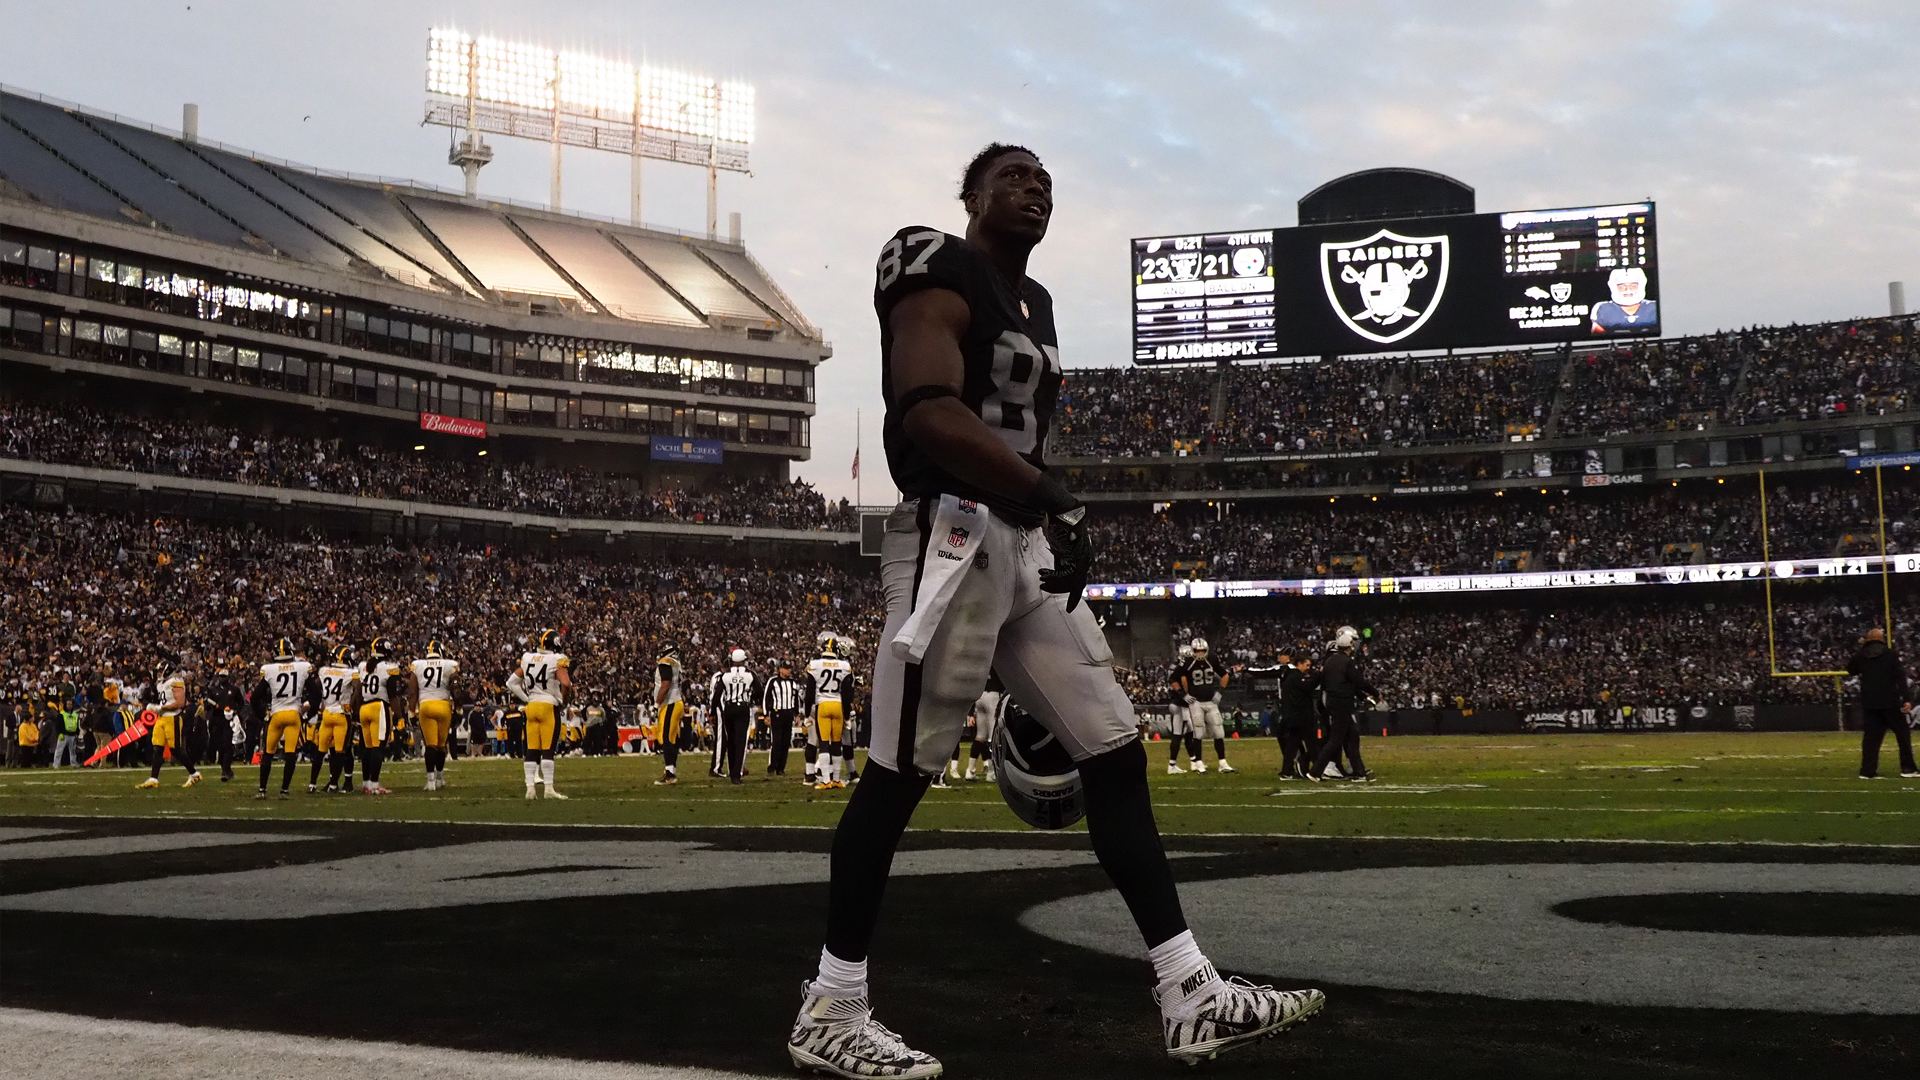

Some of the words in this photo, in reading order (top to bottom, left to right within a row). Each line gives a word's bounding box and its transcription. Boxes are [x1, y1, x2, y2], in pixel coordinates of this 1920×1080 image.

[877, 231, 945, 291] 87
[1337, 243, 1433, 262] RAIDERS
[1142, 258, 1169, 280] 23
[1203, 254, 1228, 276] 21
[1209, 283, 1237, 293] BALL
[1241, 282, 1256, 291] ON
[1156, 341, 1257, 360] #RAIDERSPIX
[424, 413, 484, 436] Budweiser
[1584, 475, 1608, 486] 95.7
[1612, 474, 1643, 484] GAME
[1689, 567, 1721, 582] OAK
[1722, 565, 1743, 580] 23
[1818, 562, 1845, 577] PIT
[1847, 560, 1867, 574] 21
[1412, 578, 1459, 590] INTERESTED
[1552, 574, 1573, 585] CALL
[276, 672, 297, 698] 21
[423, 666, 442, 688] 91
[525, 663, 548, 690] 54
[819, 669, 842, 693] 25
[323, 677, 343, 700] 34
[1181, 969, 1206, 997] NIKE
